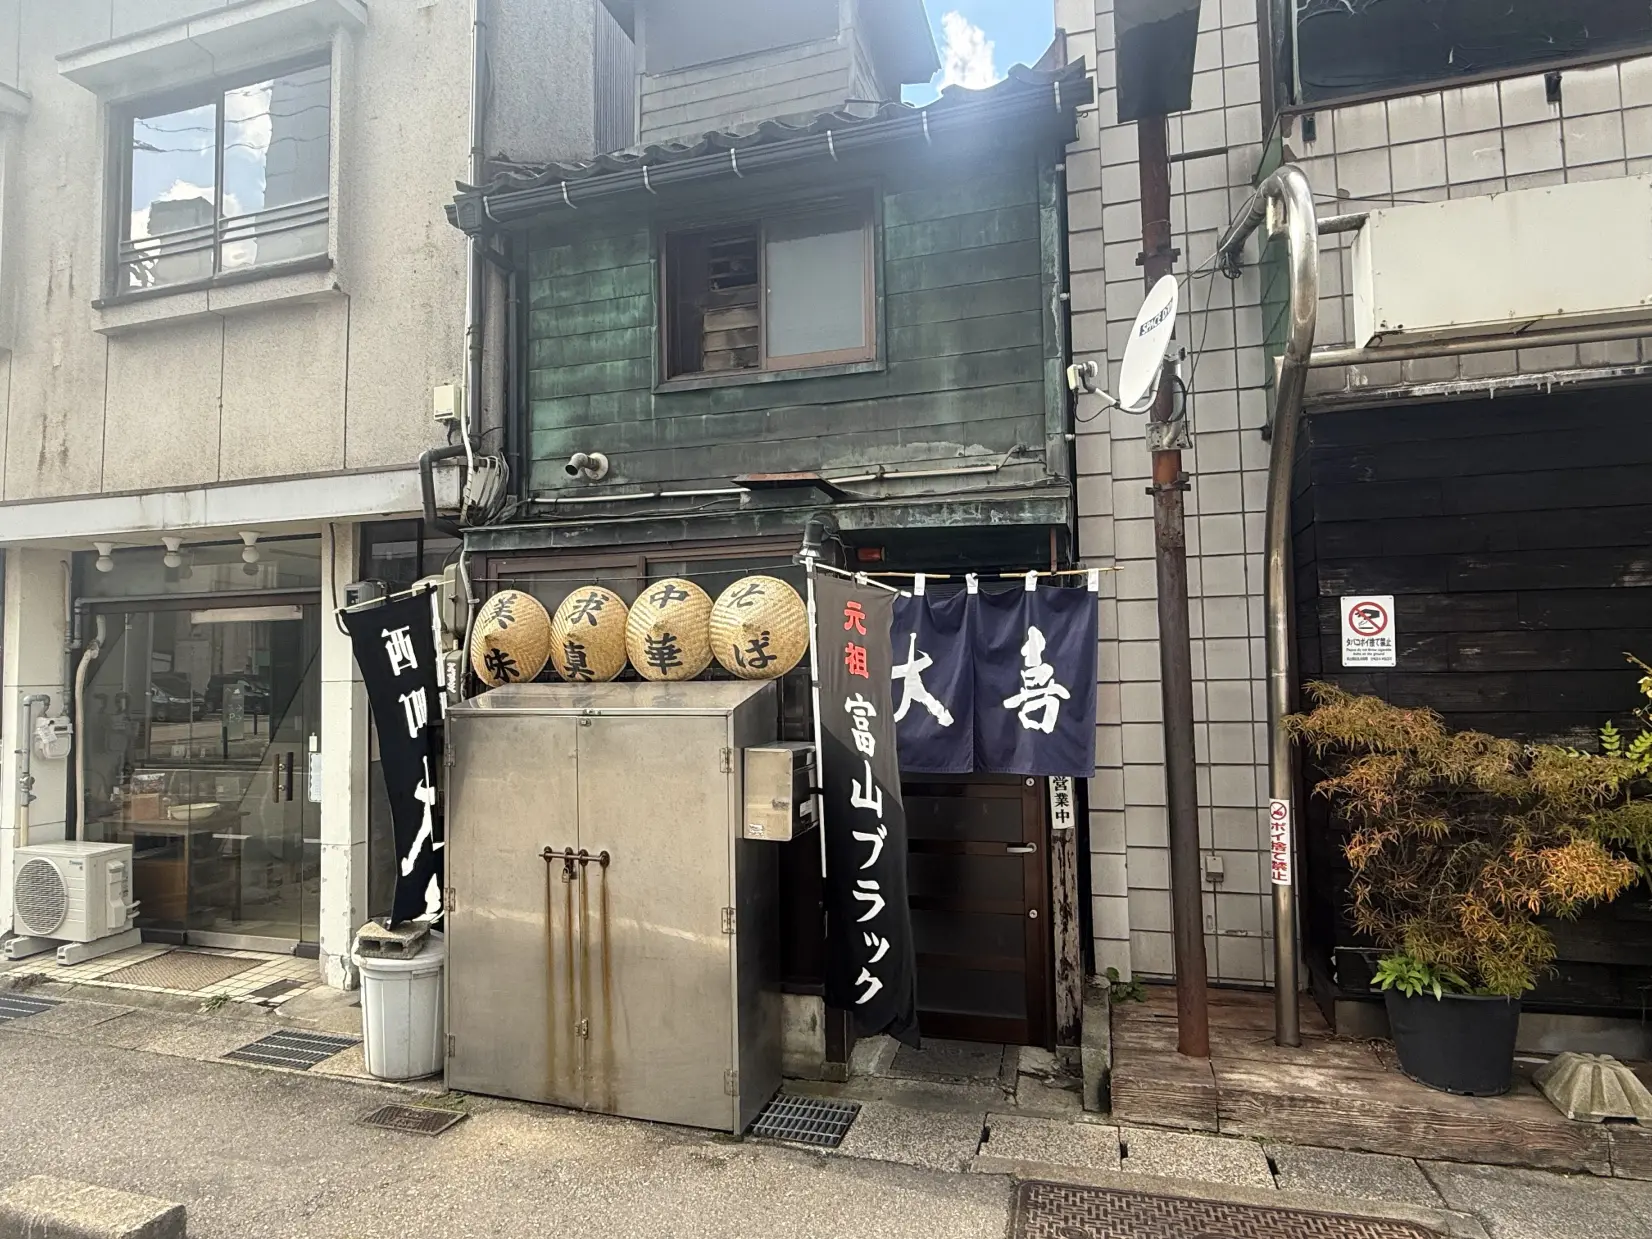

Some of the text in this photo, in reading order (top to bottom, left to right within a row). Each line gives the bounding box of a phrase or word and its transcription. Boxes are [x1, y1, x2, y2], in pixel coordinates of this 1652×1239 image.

[484, 593, 520, 682] 美味
[645, 584, 689, 675] 中華
[727, 583, 777, 669] そば
[891, 626, 1071, 734] 大喜
[1052, 777, 1071, 824] 営業中
[1270, 822, 1288, 882] ポイ捨て禁止
